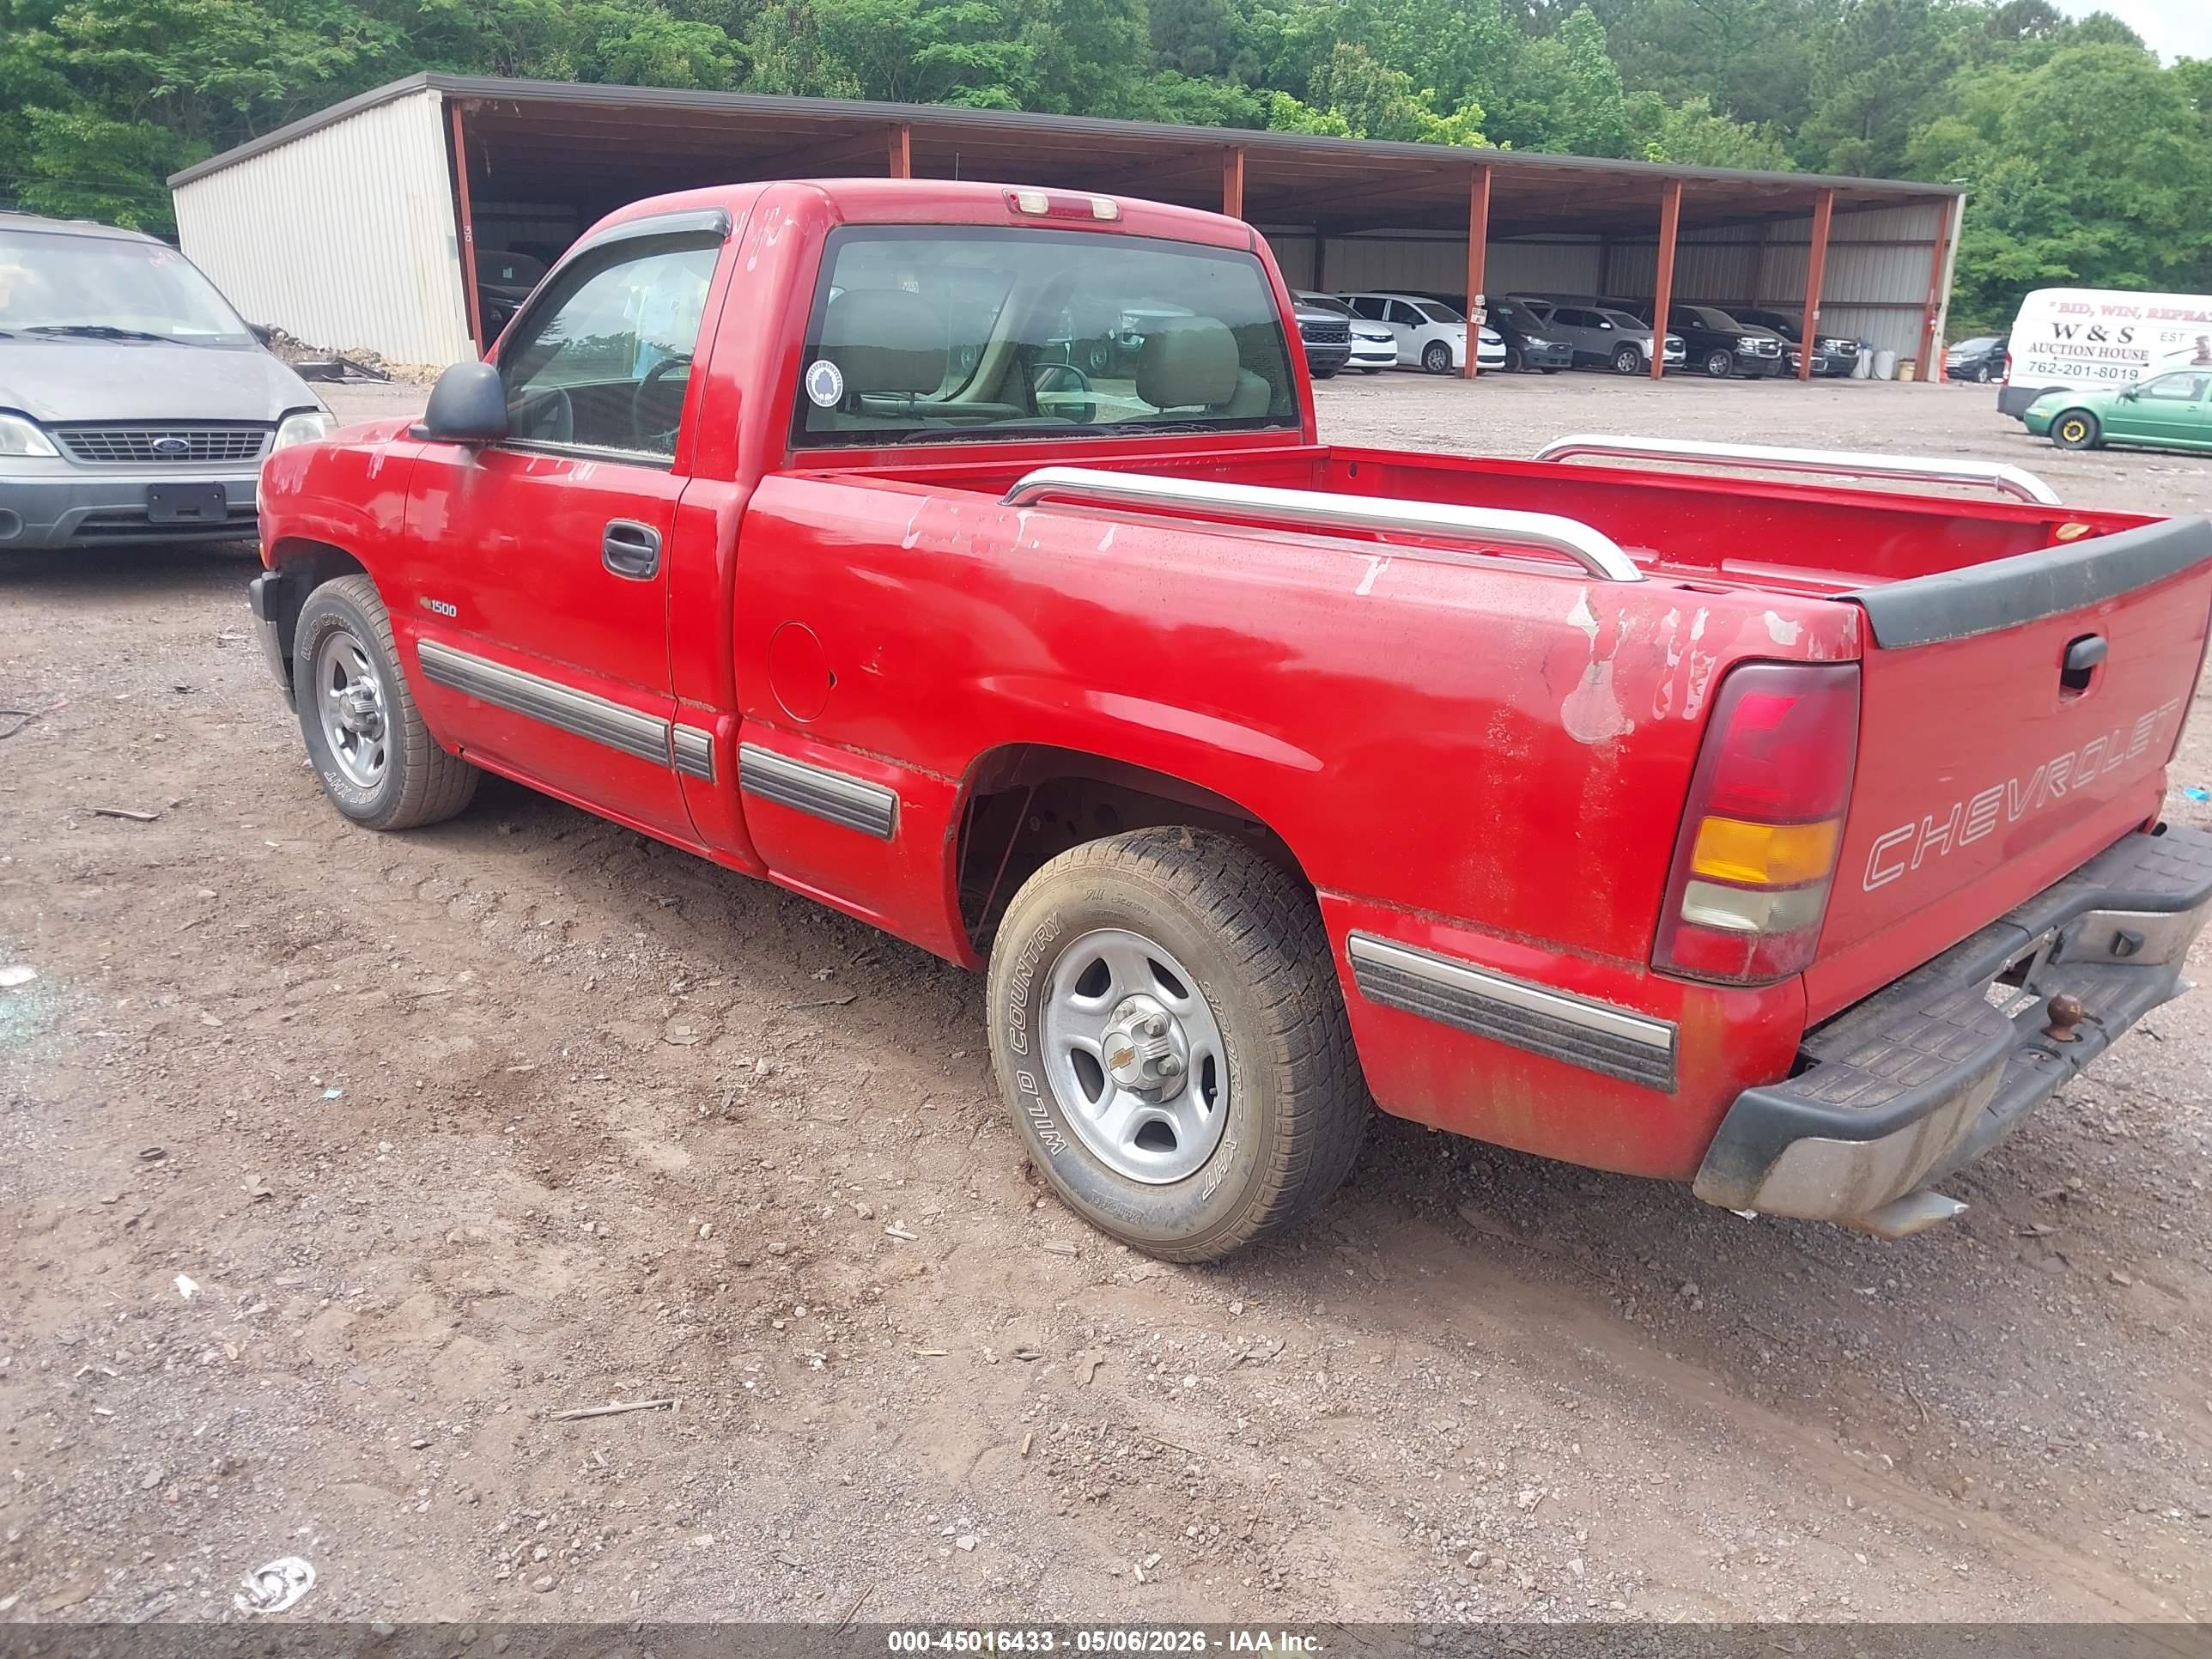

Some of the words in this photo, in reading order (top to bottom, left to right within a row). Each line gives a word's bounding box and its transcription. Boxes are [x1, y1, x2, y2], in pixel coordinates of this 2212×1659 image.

[2100, 305, 2142, 320] WIN,
[2051, 322, 2081, 339] W
[2087, 325, 2111, 343] &
[2117, 326, 2135, 344] S
[2160, 331, 2186, 343] EST
[2028, 342, 2096, 357] AUCTION
[2098, 346, 2150, 362] HOUSE
[2028, 361, 2139, 380] 762-201-8019
[432, 599, 457, 618] 1500
[301, 619, 321, 661] WILD
[324, 771, 351, 798] XHT
[1862, 697, 2180, 891] CHEVROLET
[1009, 911, 1062, 1056] COUNTRY
[1200, 981, 1243, 1121] SPORT
[1017, 1070, 1067, 1156] WILD
[1202, 1127, 1238, 1201] XHT
